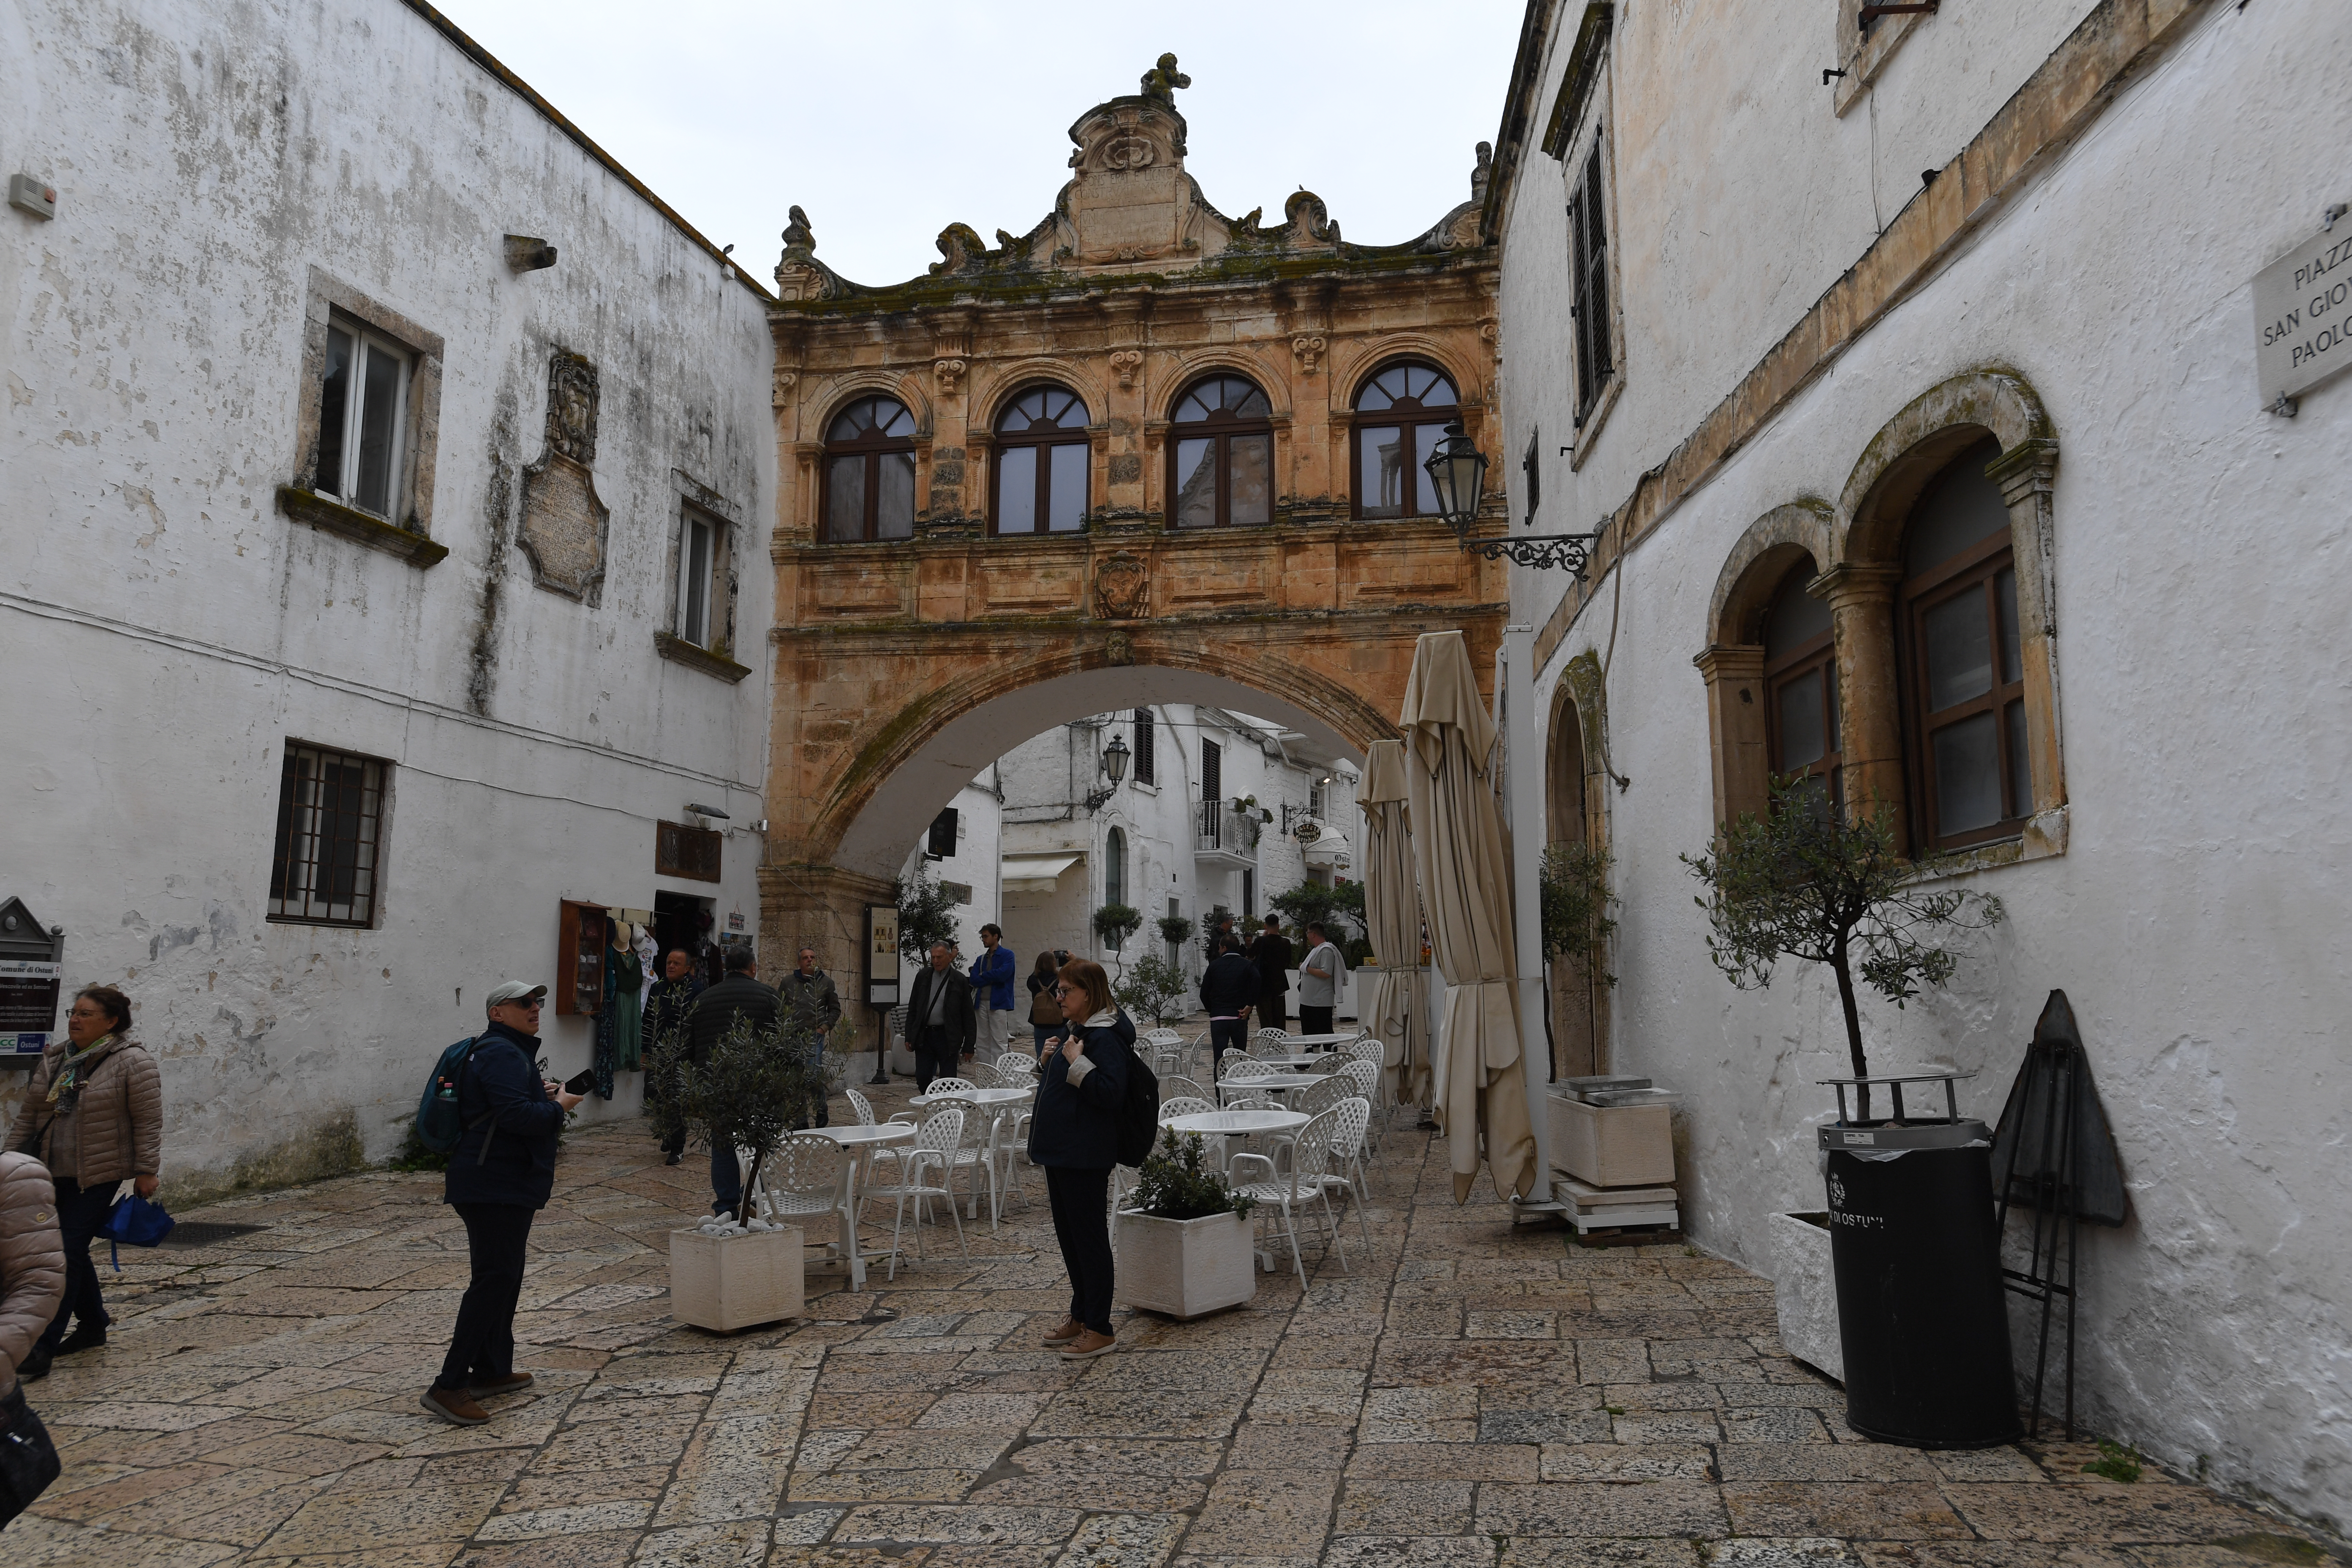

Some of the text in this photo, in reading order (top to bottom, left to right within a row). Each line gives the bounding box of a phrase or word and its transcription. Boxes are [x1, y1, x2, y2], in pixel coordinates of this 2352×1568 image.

[1081, 174, 1106, 187] PONS
[1111, 172, 1130, 185] ERAT
[1144, 168, 1174, 181] LIGNO
[2264, 308, 2301, 346] SAN
[1833, 1211, 1841, 1223] DI
